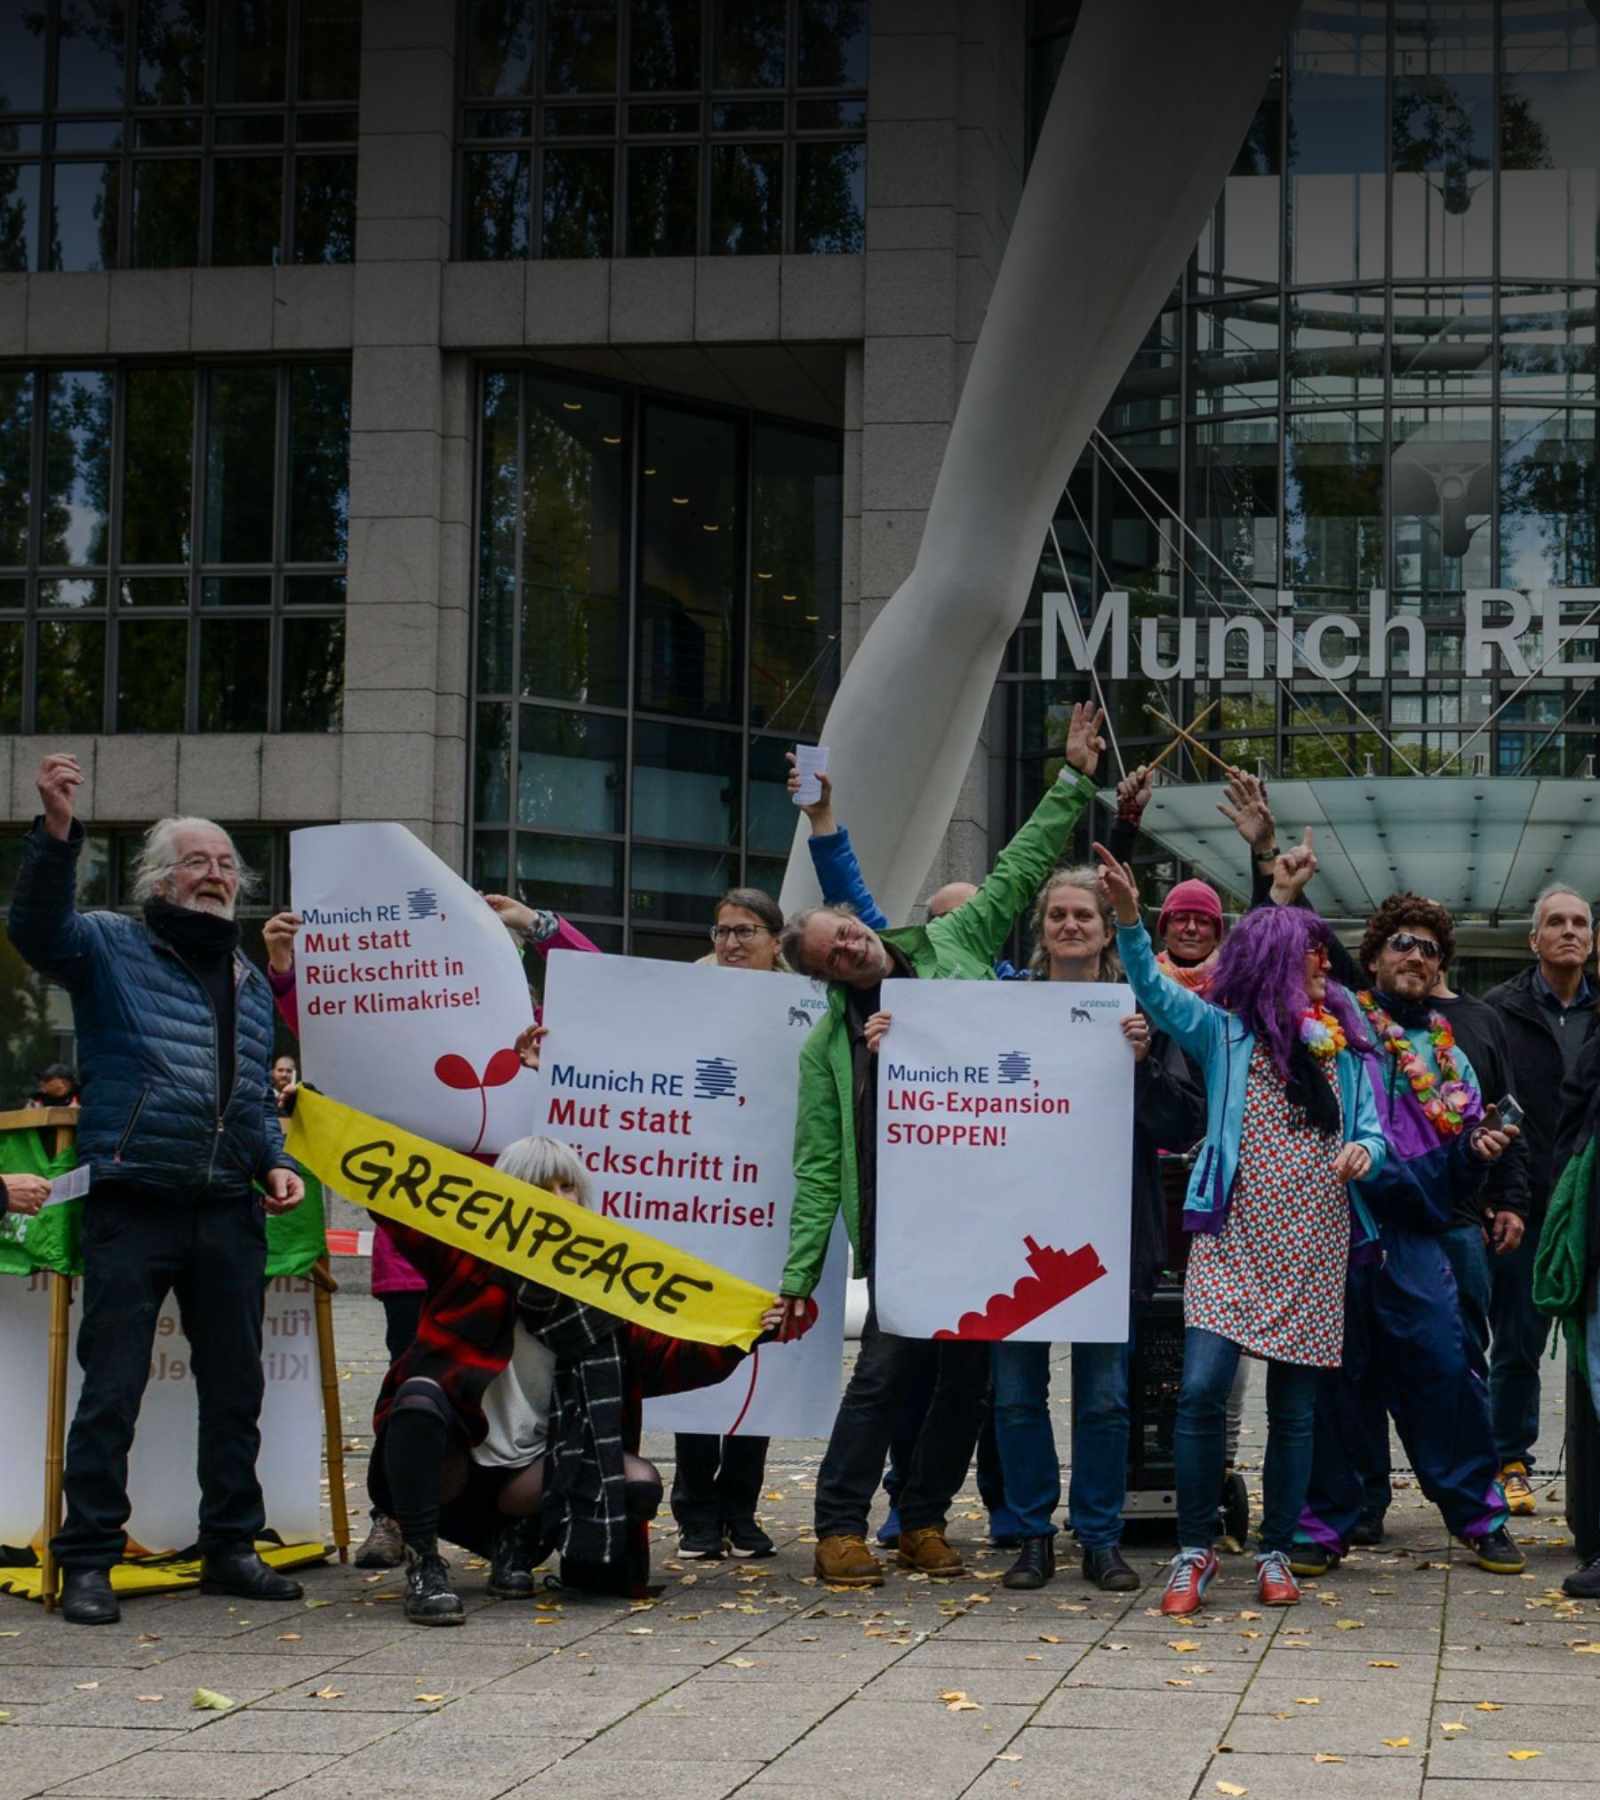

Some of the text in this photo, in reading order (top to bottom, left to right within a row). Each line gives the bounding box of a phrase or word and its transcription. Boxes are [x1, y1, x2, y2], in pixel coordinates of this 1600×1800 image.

[1041, 587, 1600, 680] Munich RE
[301, 907, 372, 925] Munich
[377, 905, 400, 921] RE
[305, 929, 412, 953] Mut statt
[306, 957, 464, 985] Rückschritt in
[307, 987, 481, 1016] der Klimakrise!
[551, 1064, 644, 1094] Munich
[651, 1073, 684, 1097] RE
[888, 1064, 959, 1084] Munich
[964, 1066, 990, 1084] RE
[547, 1098, 693, 1135] Mut statt
[888, 1090, 1070, 1118] LNG-Expansion
[887, 1123, 1007, 1148] STOPPEN!
[732, 1155, 758, 1184] in
[601, 1190, 776, 1228] Klimakrise!
[340, 1139, 714, 1315] GREENPEACE
